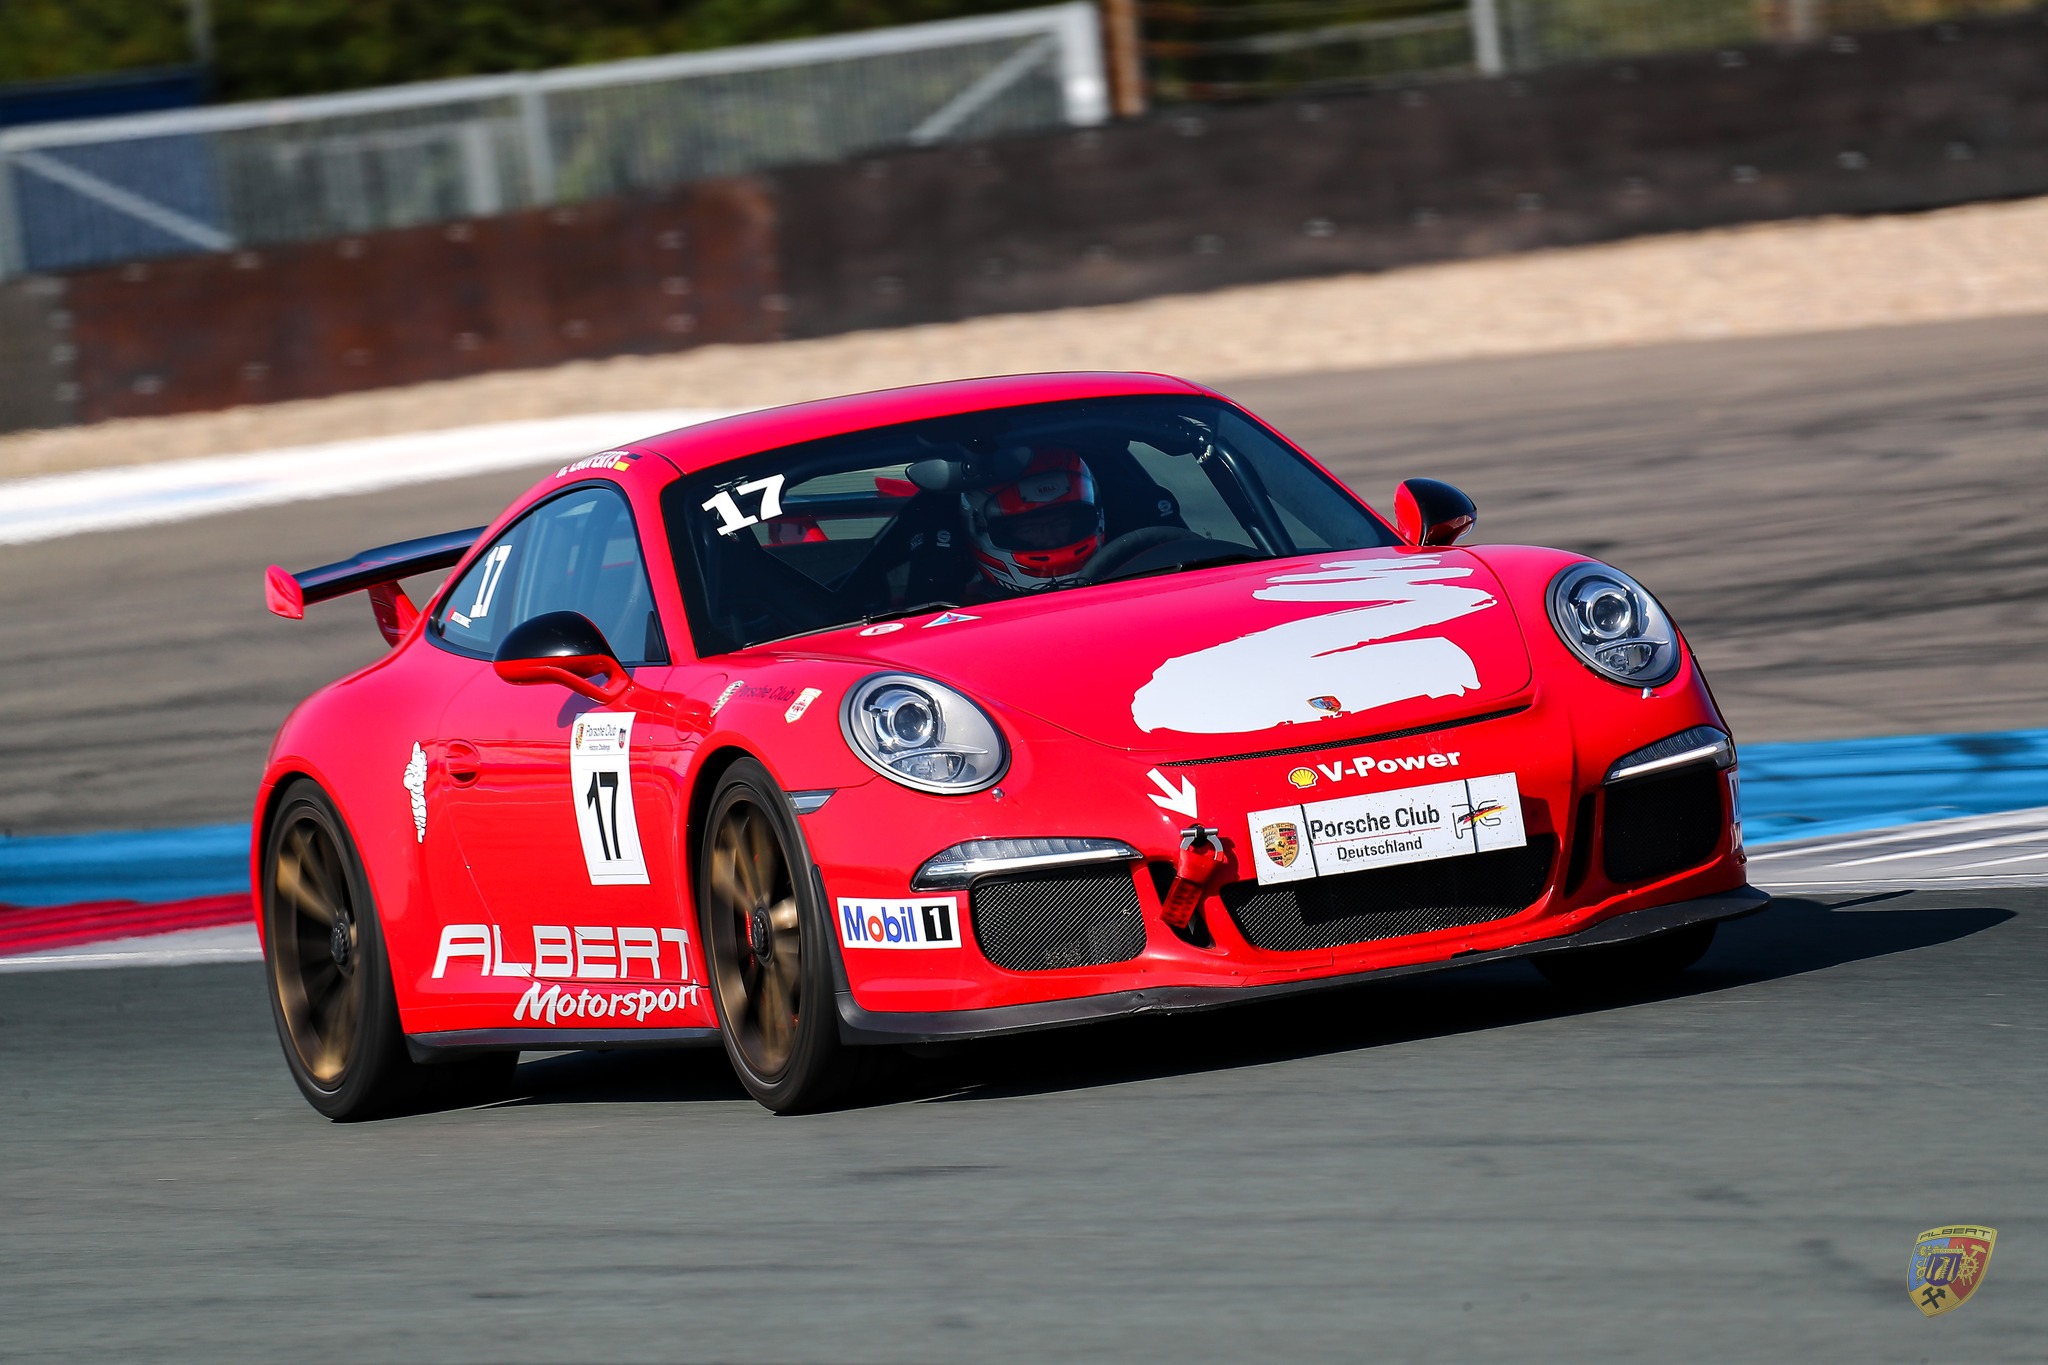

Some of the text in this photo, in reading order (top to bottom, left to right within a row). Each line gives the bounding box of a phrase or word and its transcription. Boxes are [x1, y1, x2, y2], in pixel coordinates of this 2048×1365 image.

[702, 473, 785, 536] 17
[469, 545, 512, 618] 17
[1317, 751, 1460, 782] V-Power
[587, 771, 622, 861] 17
[1310, 804, 1441, 840] Porsche Club
[1337, 836, 1423, 862] Deutschland
[843, 905, 945, 943] Mobil 1
[431, 924, 689, 980] ALBERT
[512, 979, 700, 1025] Motorsport
